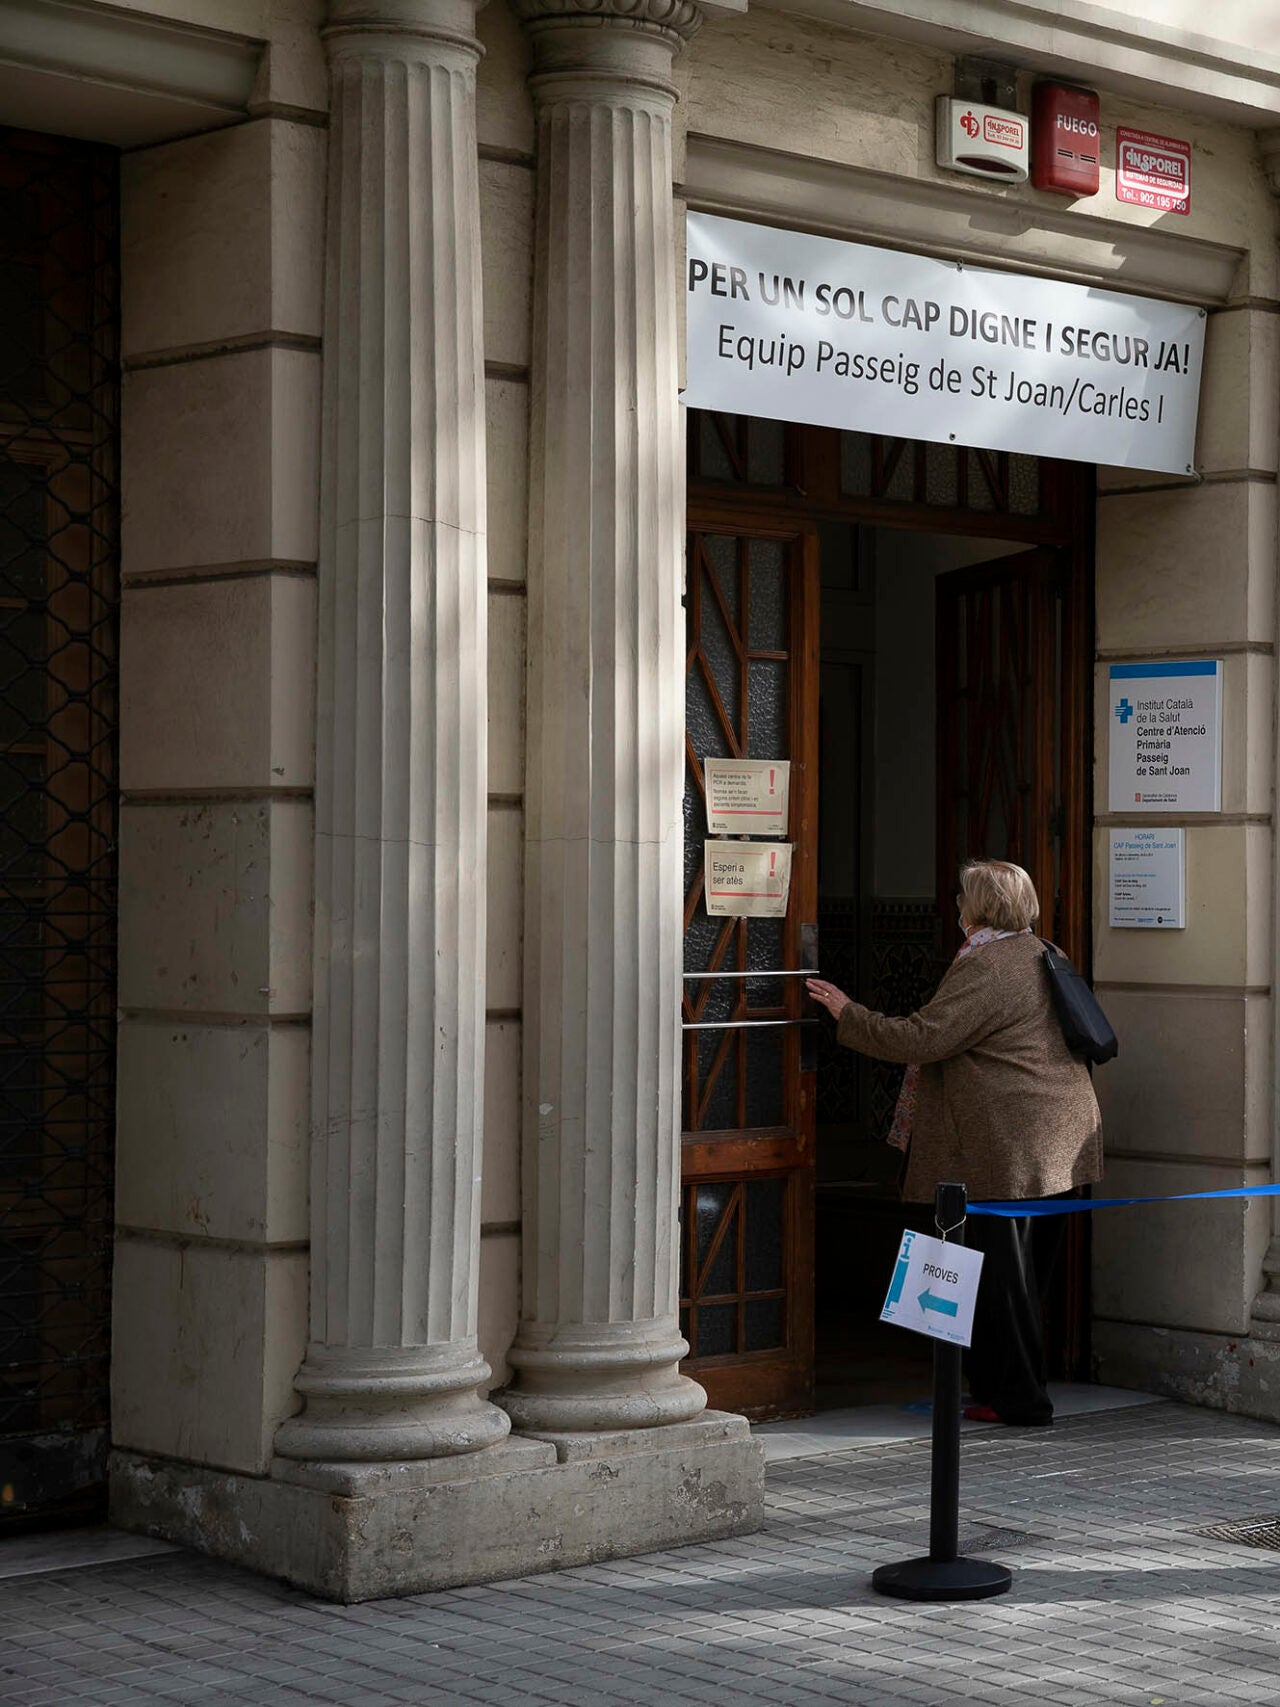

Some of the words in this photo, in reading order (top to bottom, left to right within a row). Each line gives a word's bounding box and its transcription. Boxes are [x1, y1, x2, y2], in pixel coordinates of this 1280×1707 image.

[1056, 113, 1097, 137] FUEGO
[1125, 171, 1149, 183] SISTEMAS
[1149, 176, 1157, 184] DE
[1157, 178, 1183, 190] SEGURIDAD
[1122, 188, 1138, 201] Tel.:
[1140, 192, 1155, 204] 902
[1157, 196, 1170, 208] 195
[1172, 198, 1186, 211] 750
[689, 258, 749, 301] PER
[759, 272, 805, 312] UN
[815, 283, 874, 324] SOL
[881, 295, 941, 332] CAP
[949, 306, 1036, 350] DIGNE
[1045, 324, 1052, 353] I
[1060, 326, 1149, 368] SEGUR
[1154, 342, 1191, 375] JA!
[717, 324, 805, 376] Equip
[817, 341, 919, 395] Passeig
[929, 358, 962, 395] de
[970, 365, 998, 400] St
[1004, 370, 1150, 422] Joan/Carles
[1156, 395, 1164, 424] I
[1137, 699, 1165, 711] Institut
[1166, 698, 1193, 710] Català
[1136, 714, 1147, 724] de
[1149, 713, 1157, 723] la
[1158, 712, 1181, 723] Salut
[1136, 727, 1168, 737] Centre
[1167, 724, 1206, 736] d'Atenció
[1136, 739, 1171, 750] Primària
[1136, 753, 1169, 765] Passeig
[1136, 766, 1147, 776] de
[1149, 766, 1168, 776] Sant
[1170, 765, 1190, 776] Joan
[713, 861, 737, 873] Esperi
[739, 864, 745, 872] a
[712, 876, 724, 885] ser
[922, 1263, 959, 1284] PROVES
